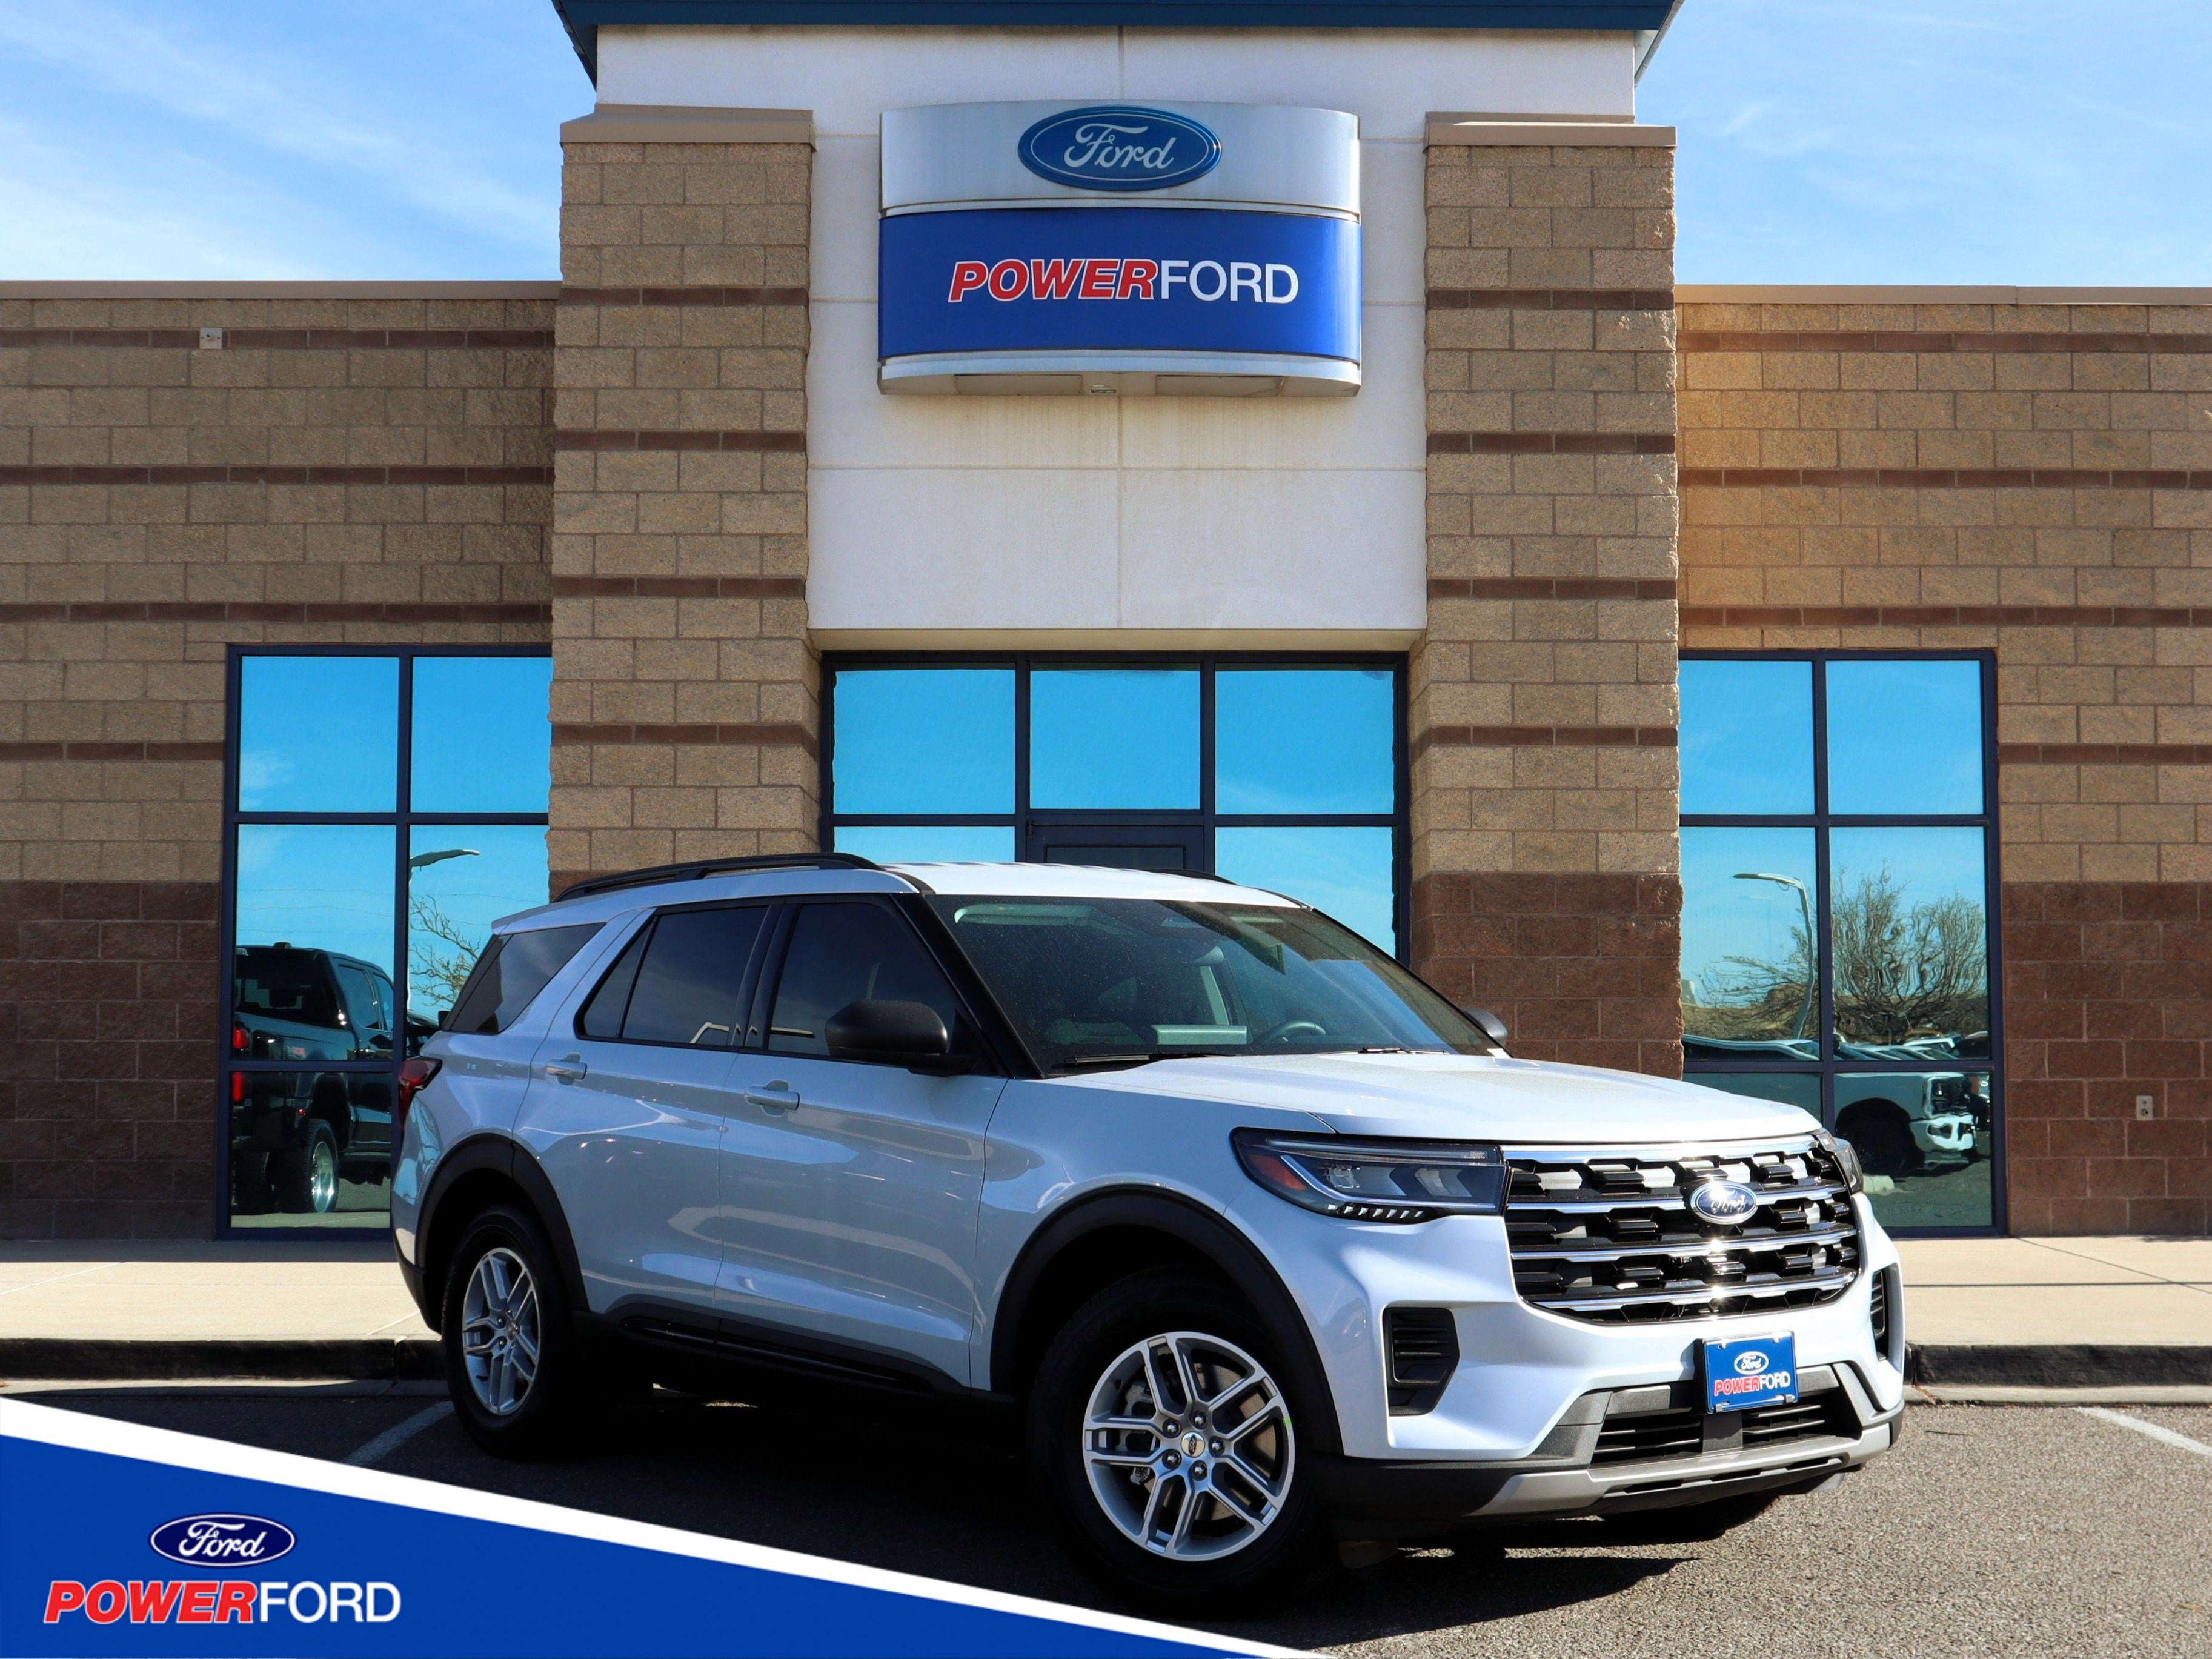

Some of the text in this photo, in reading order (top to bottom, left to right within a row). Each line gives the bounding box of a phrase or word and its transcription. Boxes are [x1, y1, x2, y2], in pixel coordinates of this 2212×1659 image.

[1064, 122, 1177, 169] Ford
[948, 258, 1299, 304] POWERFORD
[1741, 1355, 1762, 1370] Ford
[1714, 1371, 1791, 1396] POWERFORD
